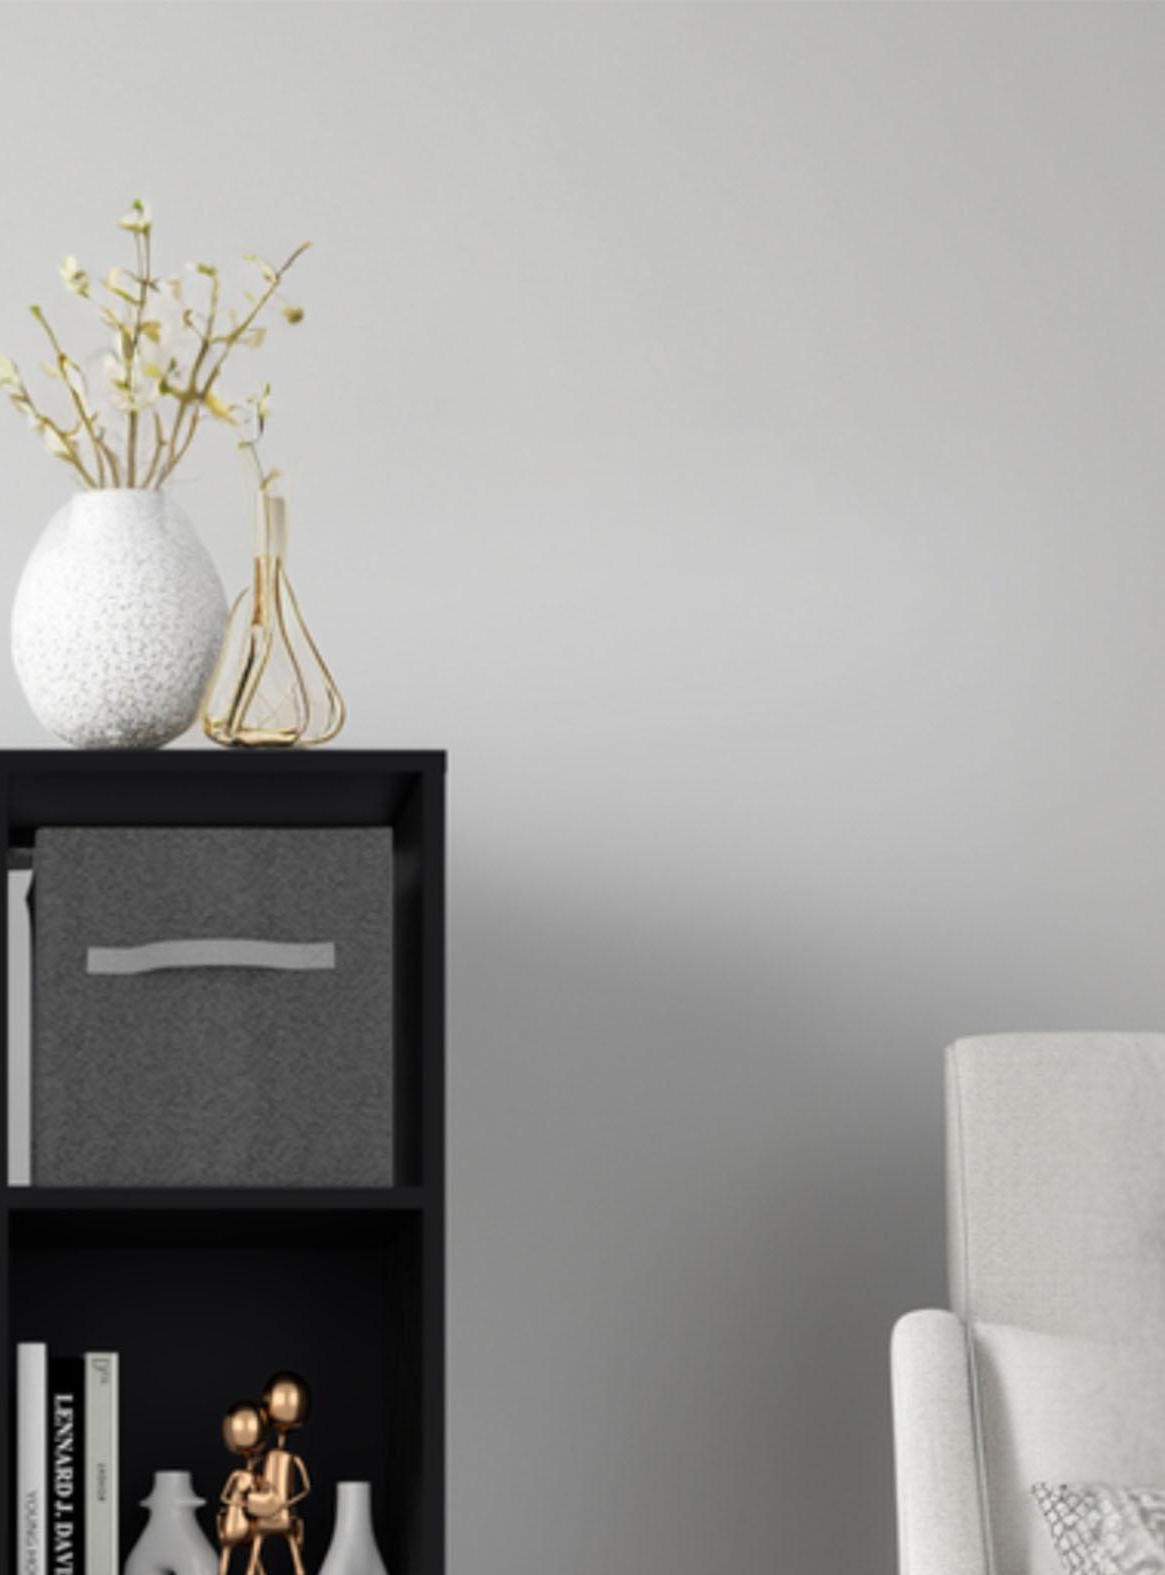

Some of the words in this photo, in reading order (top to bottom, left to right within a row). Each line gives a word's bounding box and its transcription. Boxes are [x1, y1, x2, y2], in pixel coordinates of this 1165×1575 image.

[53, 1393, 75, 1498] LENNARD
[24, 1489, 40, 1547] YOUNG
[53, 1499, 75, 1517] J.
